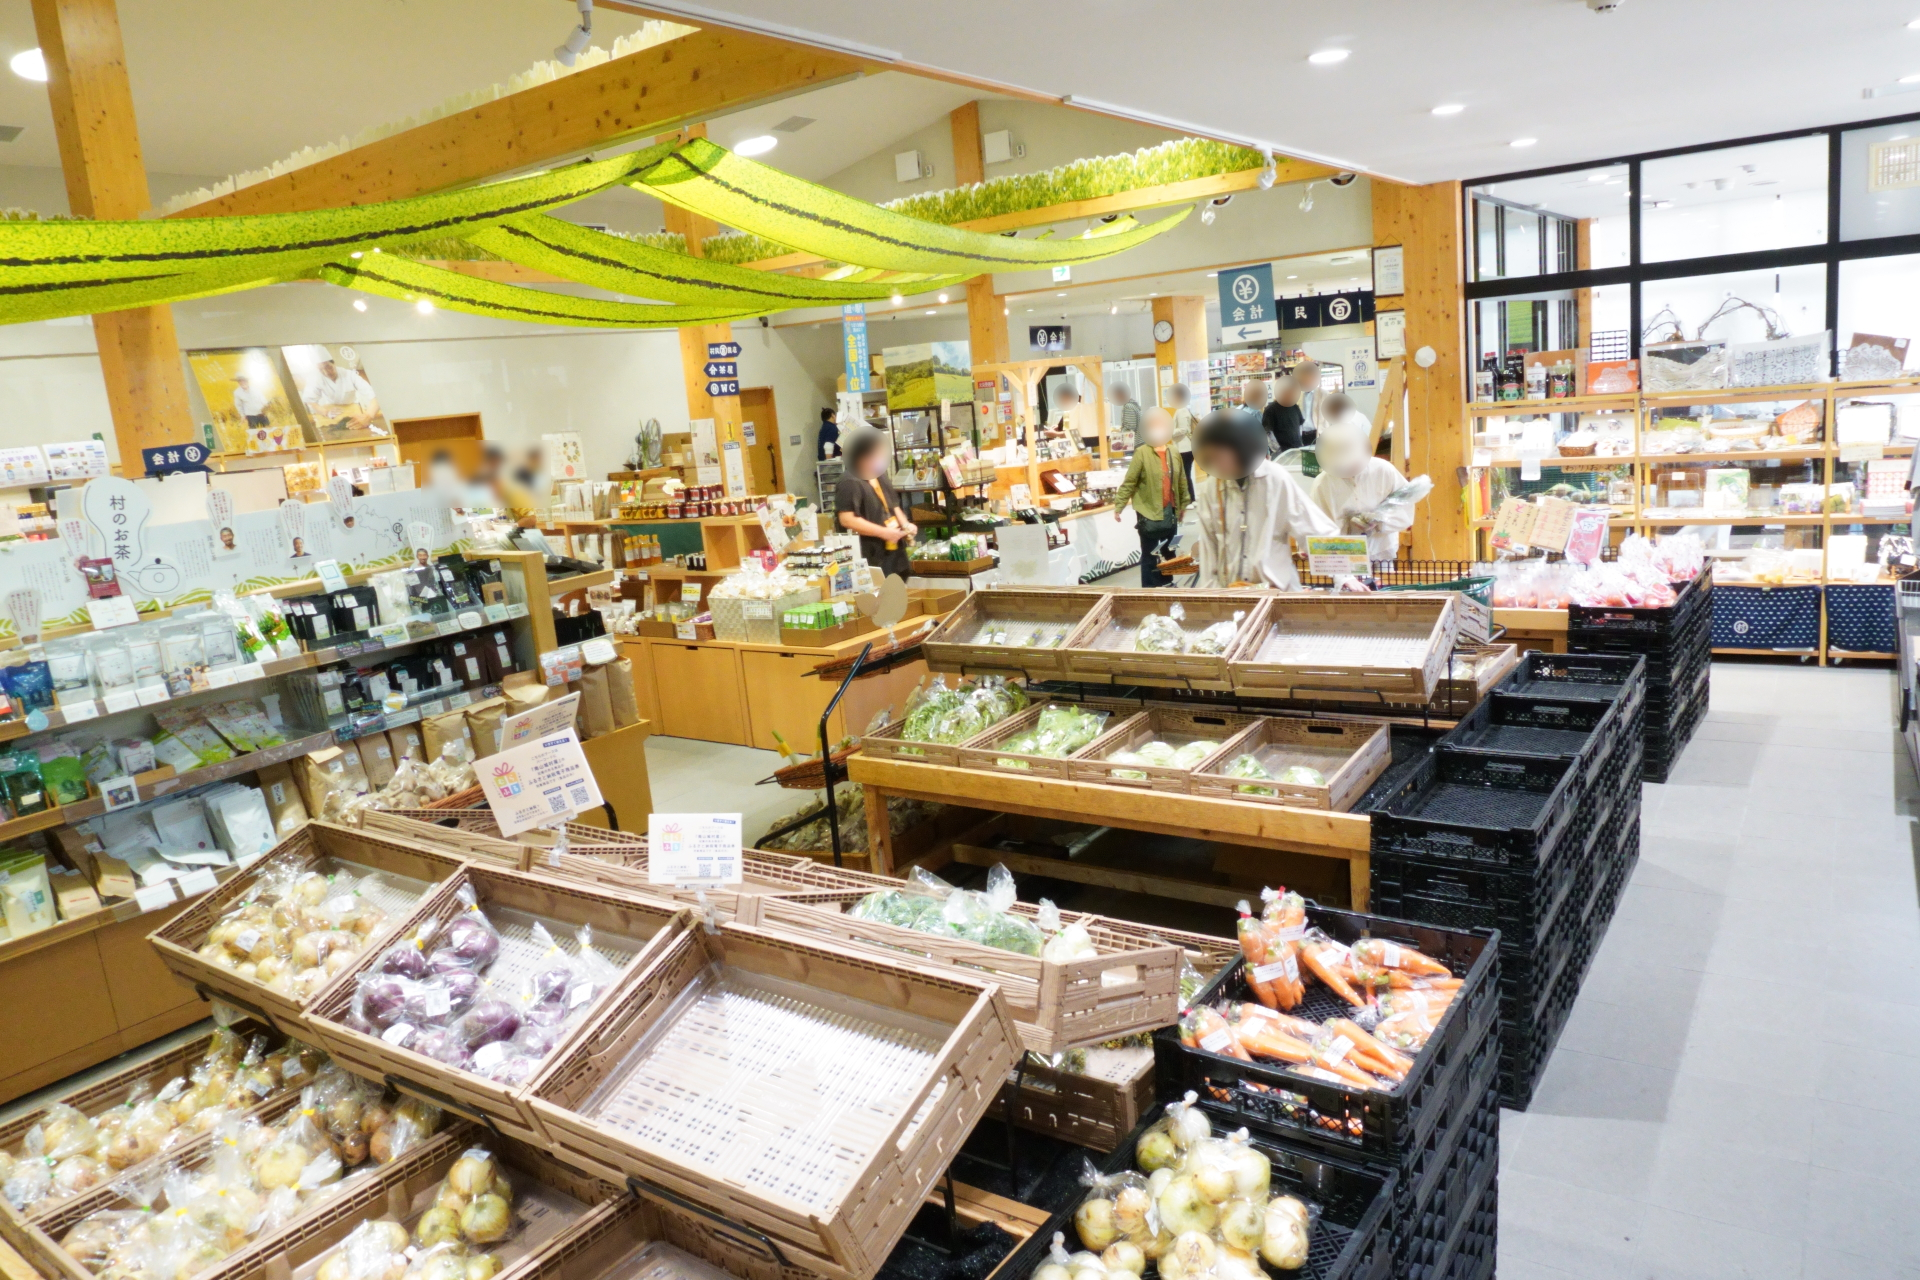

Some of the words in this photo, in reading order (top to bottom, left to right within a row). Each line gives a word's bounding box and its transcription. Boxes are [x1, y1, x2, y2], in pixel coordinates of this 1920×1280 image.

[1232, 304, 1264, 322] 会計
[1295, 306, 1308, 320] 民
[846, 333, 860, 392] 全国1位
[1351, 353, 1369, 361] スタンプ
[720, 383, 736, 393] WC
[1267, 384, 1273, 399] 入口
[152, 450, 181, 466] 会計
[109, 494, 131, 561] 村のお茶
